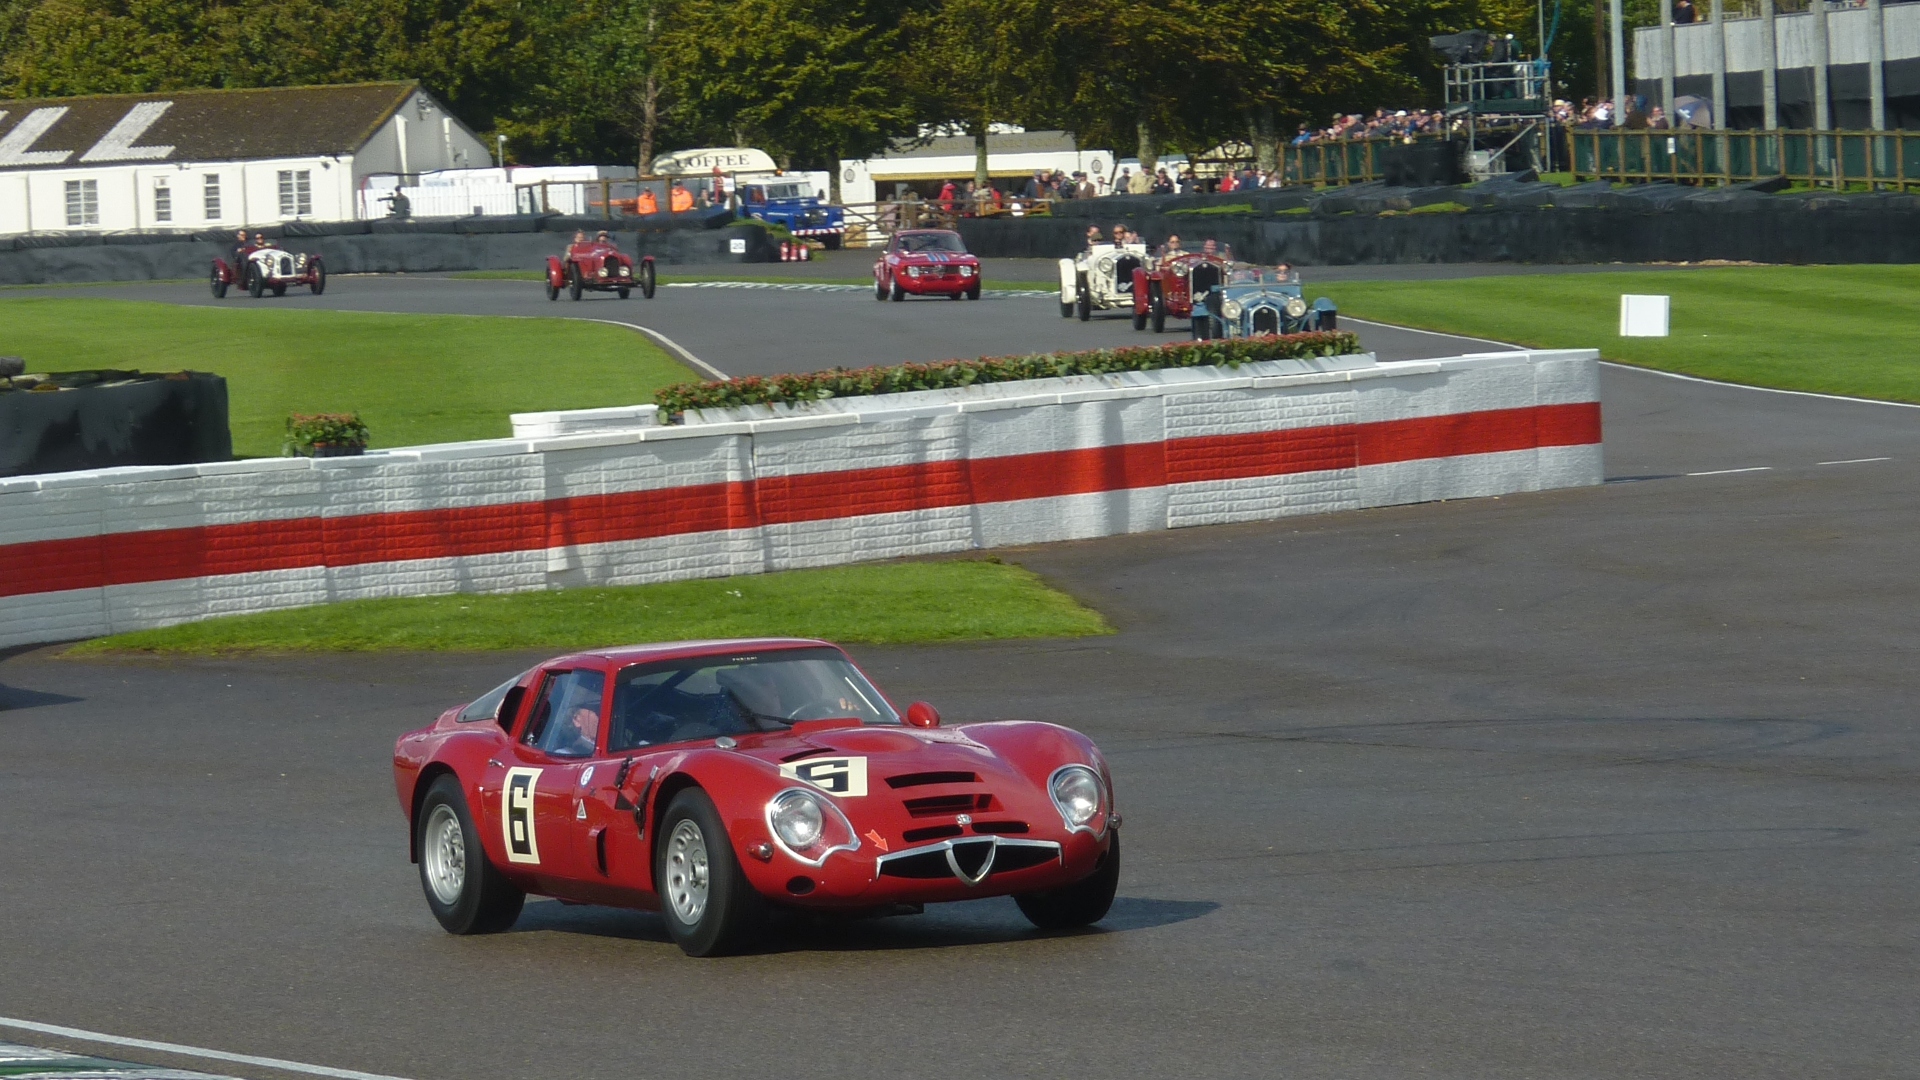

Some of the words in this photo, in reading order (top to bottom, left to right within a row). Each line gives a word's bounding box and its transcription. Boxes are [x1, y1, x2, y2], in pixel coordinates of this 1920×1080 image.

[0, 101, 176, 166] LL
[676, 154, 750, 168] COFFEE
[508, 773, 533, 856] 6
